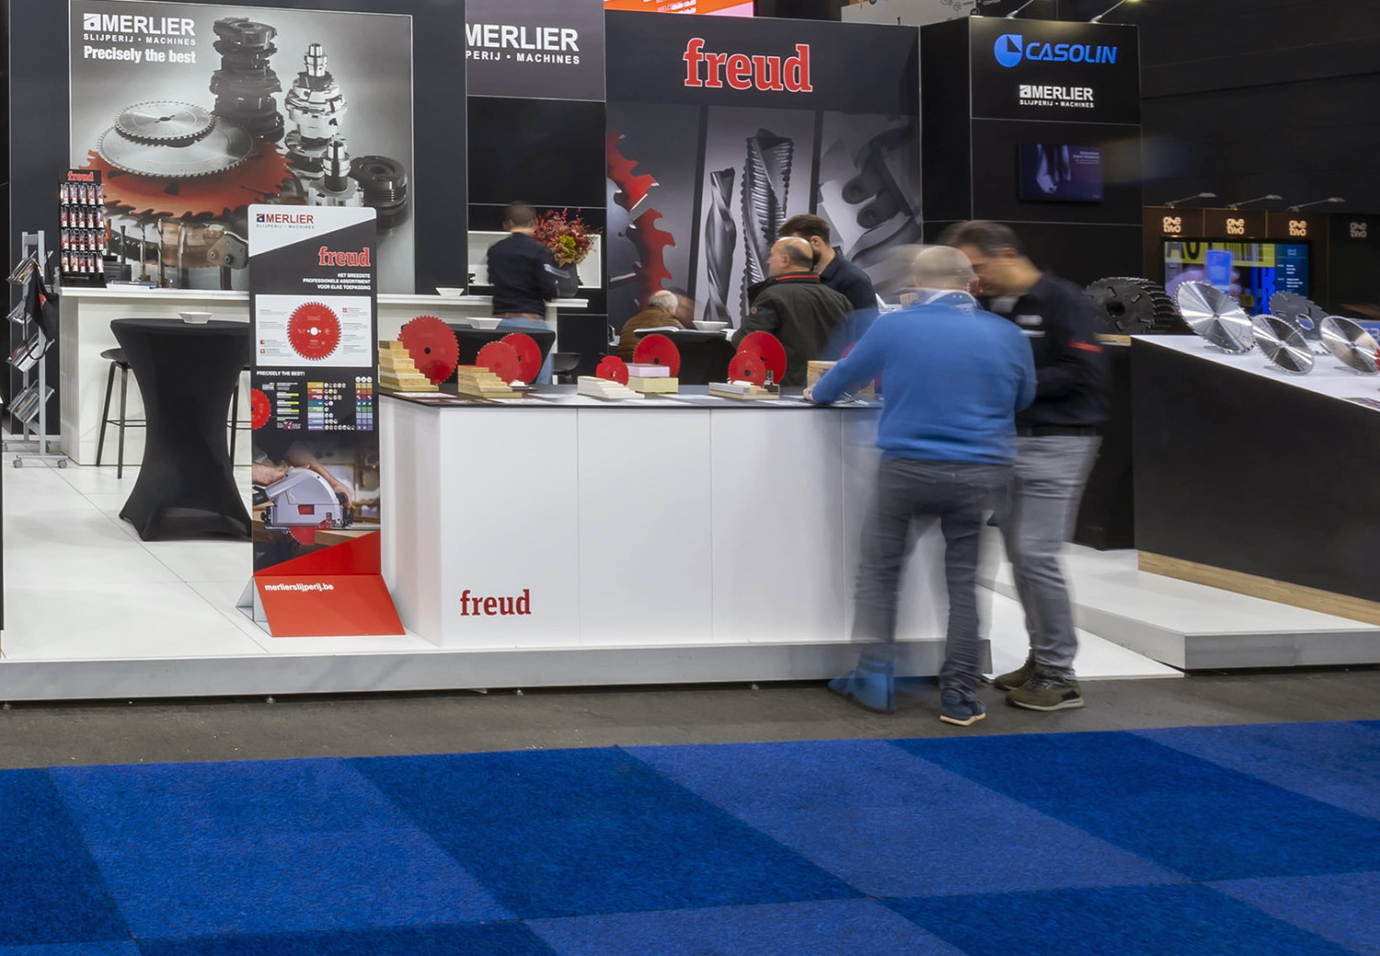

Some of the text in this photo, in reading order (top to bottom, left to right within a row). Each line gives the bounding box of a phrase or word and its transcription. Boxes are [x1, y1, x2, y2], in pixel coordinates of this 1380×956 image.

[102, 14, 196, 36] MERLIER
[83, 33, 196, 46] SLIJPERIJ MACHINES
[465, 23, 580, 52] MERLIER
[83, 45, 197, 64] Precisely the best
[516, 53, 580, 65] MACHINES
[1025, 42, 1118, 65] CASOLIN
[682, 37, 813, 92] freud
[1032, 85, 1094, 101] MERLIER
[1019, 99, 1053, 107] SLIJPERIJ
[68, 171, 94, 182] freud
[266, 214, 314, 224] MERLIER
[318, 246, 371, 266] freud
[459, 589, 532, 616] freud
